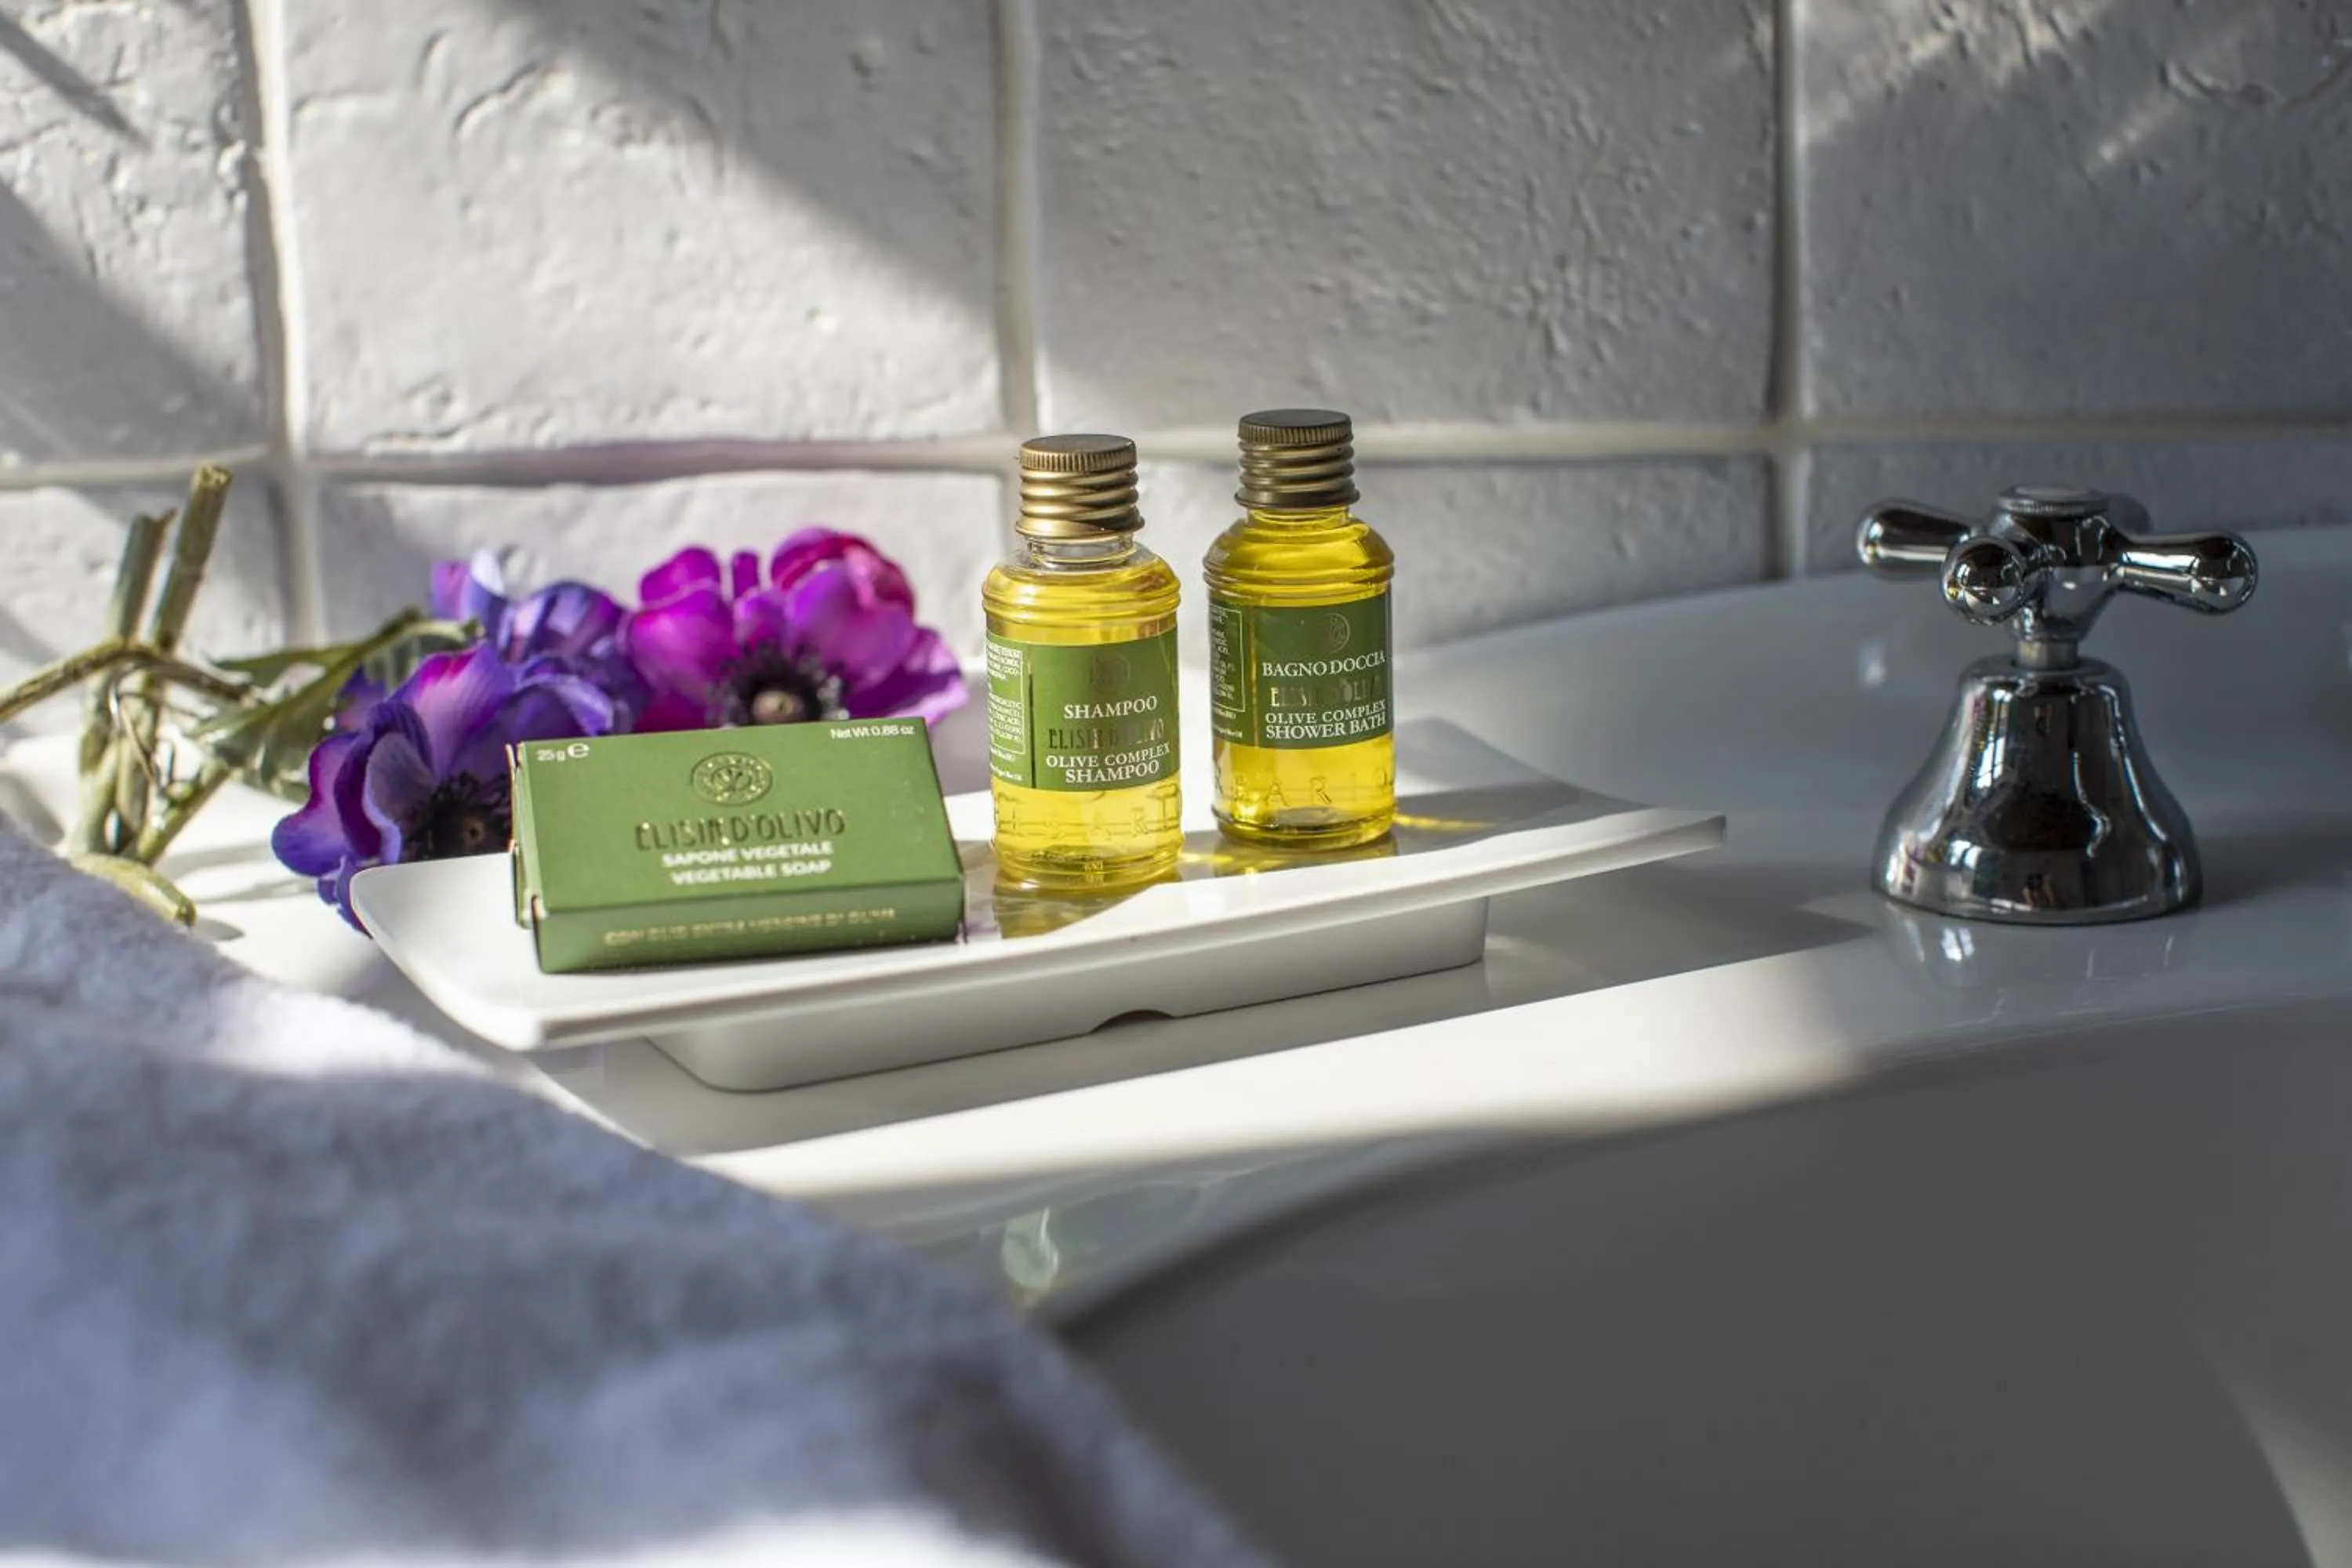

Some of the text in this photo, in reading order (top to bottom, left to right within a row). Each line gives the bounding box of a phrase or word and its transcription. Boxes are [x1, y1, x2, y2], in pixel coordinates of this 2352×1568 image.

[1262, 651, 1386, 677] BAGNO DOCCIA
[1064, 695, 1158, 719] SHAMPOO
[1265, 699, 1387, 724] OLIVE COMPLEX
[1266, 713, 1387, 739] SHOWER BATH
[1046, 742, 1171, 768] OLIVE COMPLEX
[1065, 760, 1160, 783] SHAMPOO
[662, 840, 833, 868] SAPONE VEGETALE
[670, 859, 832, 885] VEGETABLE SOAP
